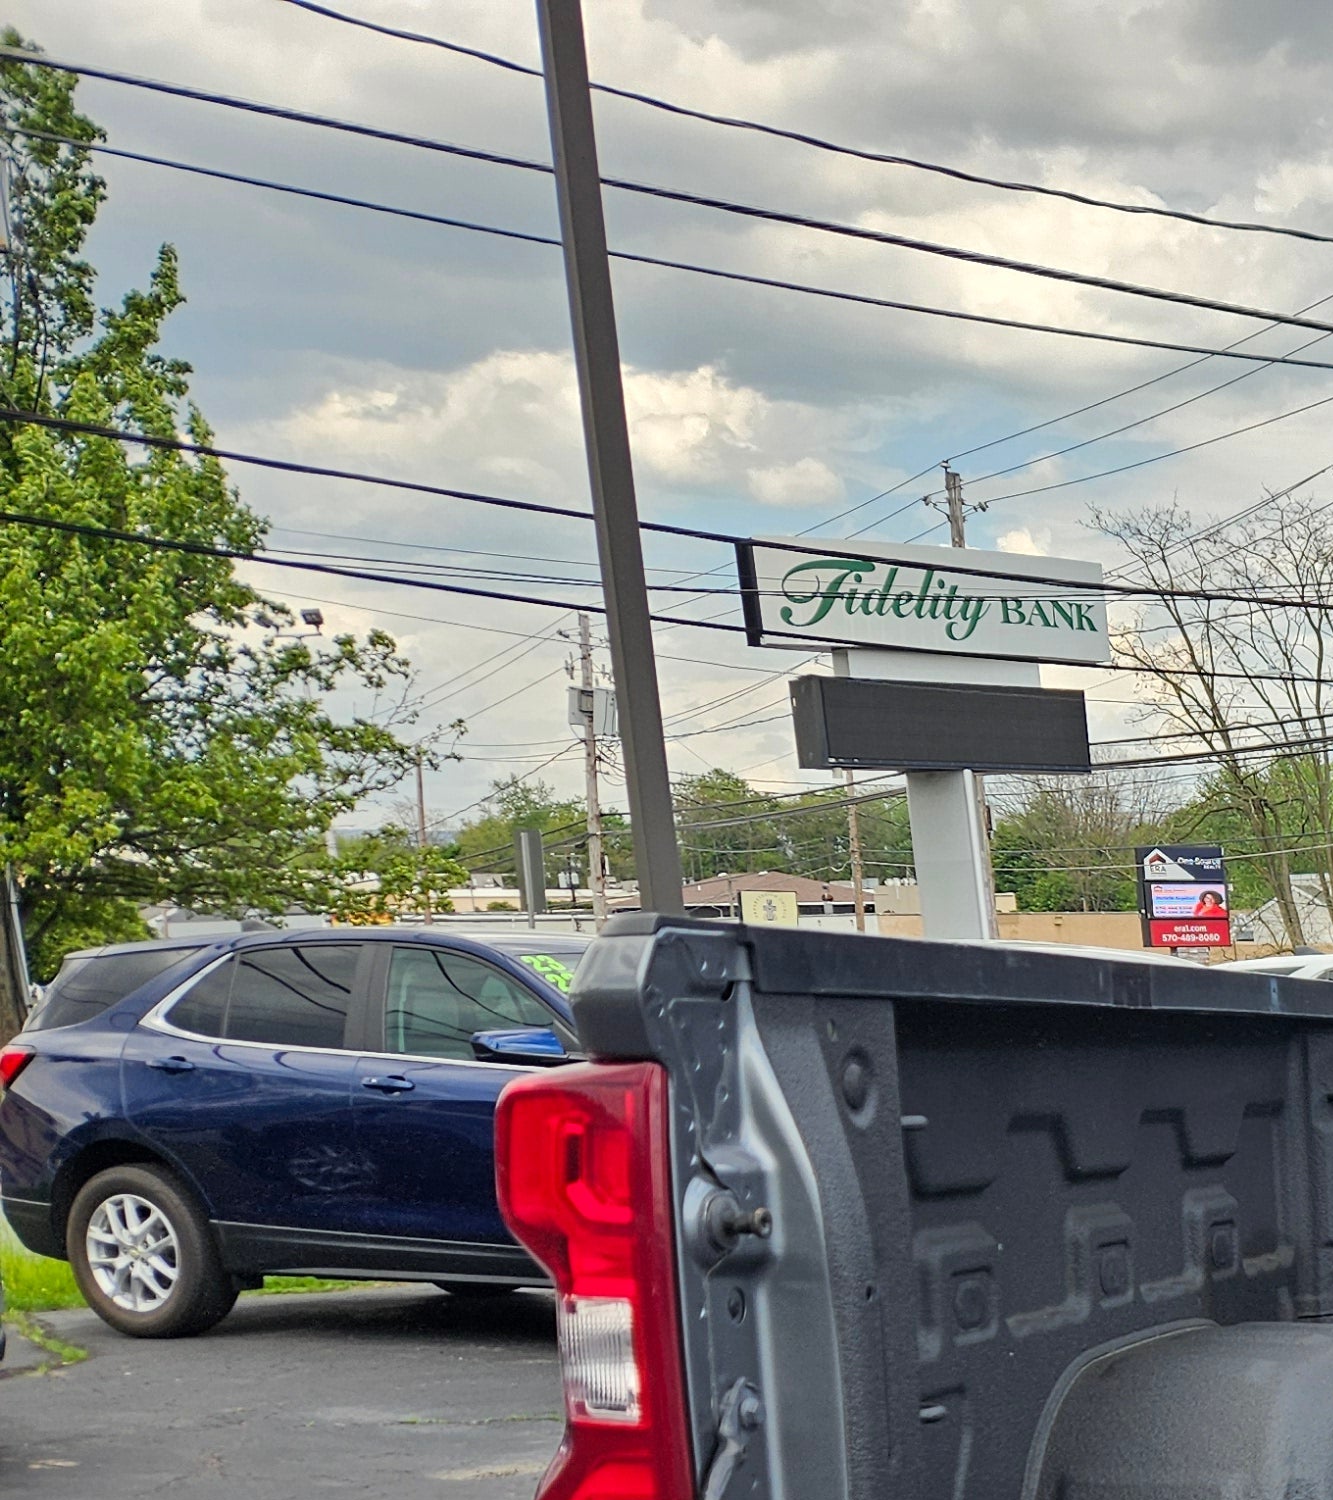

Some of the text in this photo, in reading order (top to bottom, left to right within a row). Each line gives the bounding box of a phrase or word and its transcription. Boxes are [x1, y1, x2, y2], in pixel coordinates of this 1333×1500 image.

[780, 559, 1098, 640] Fidelity BANK
[1150, 865, 1166, 873] ERA
